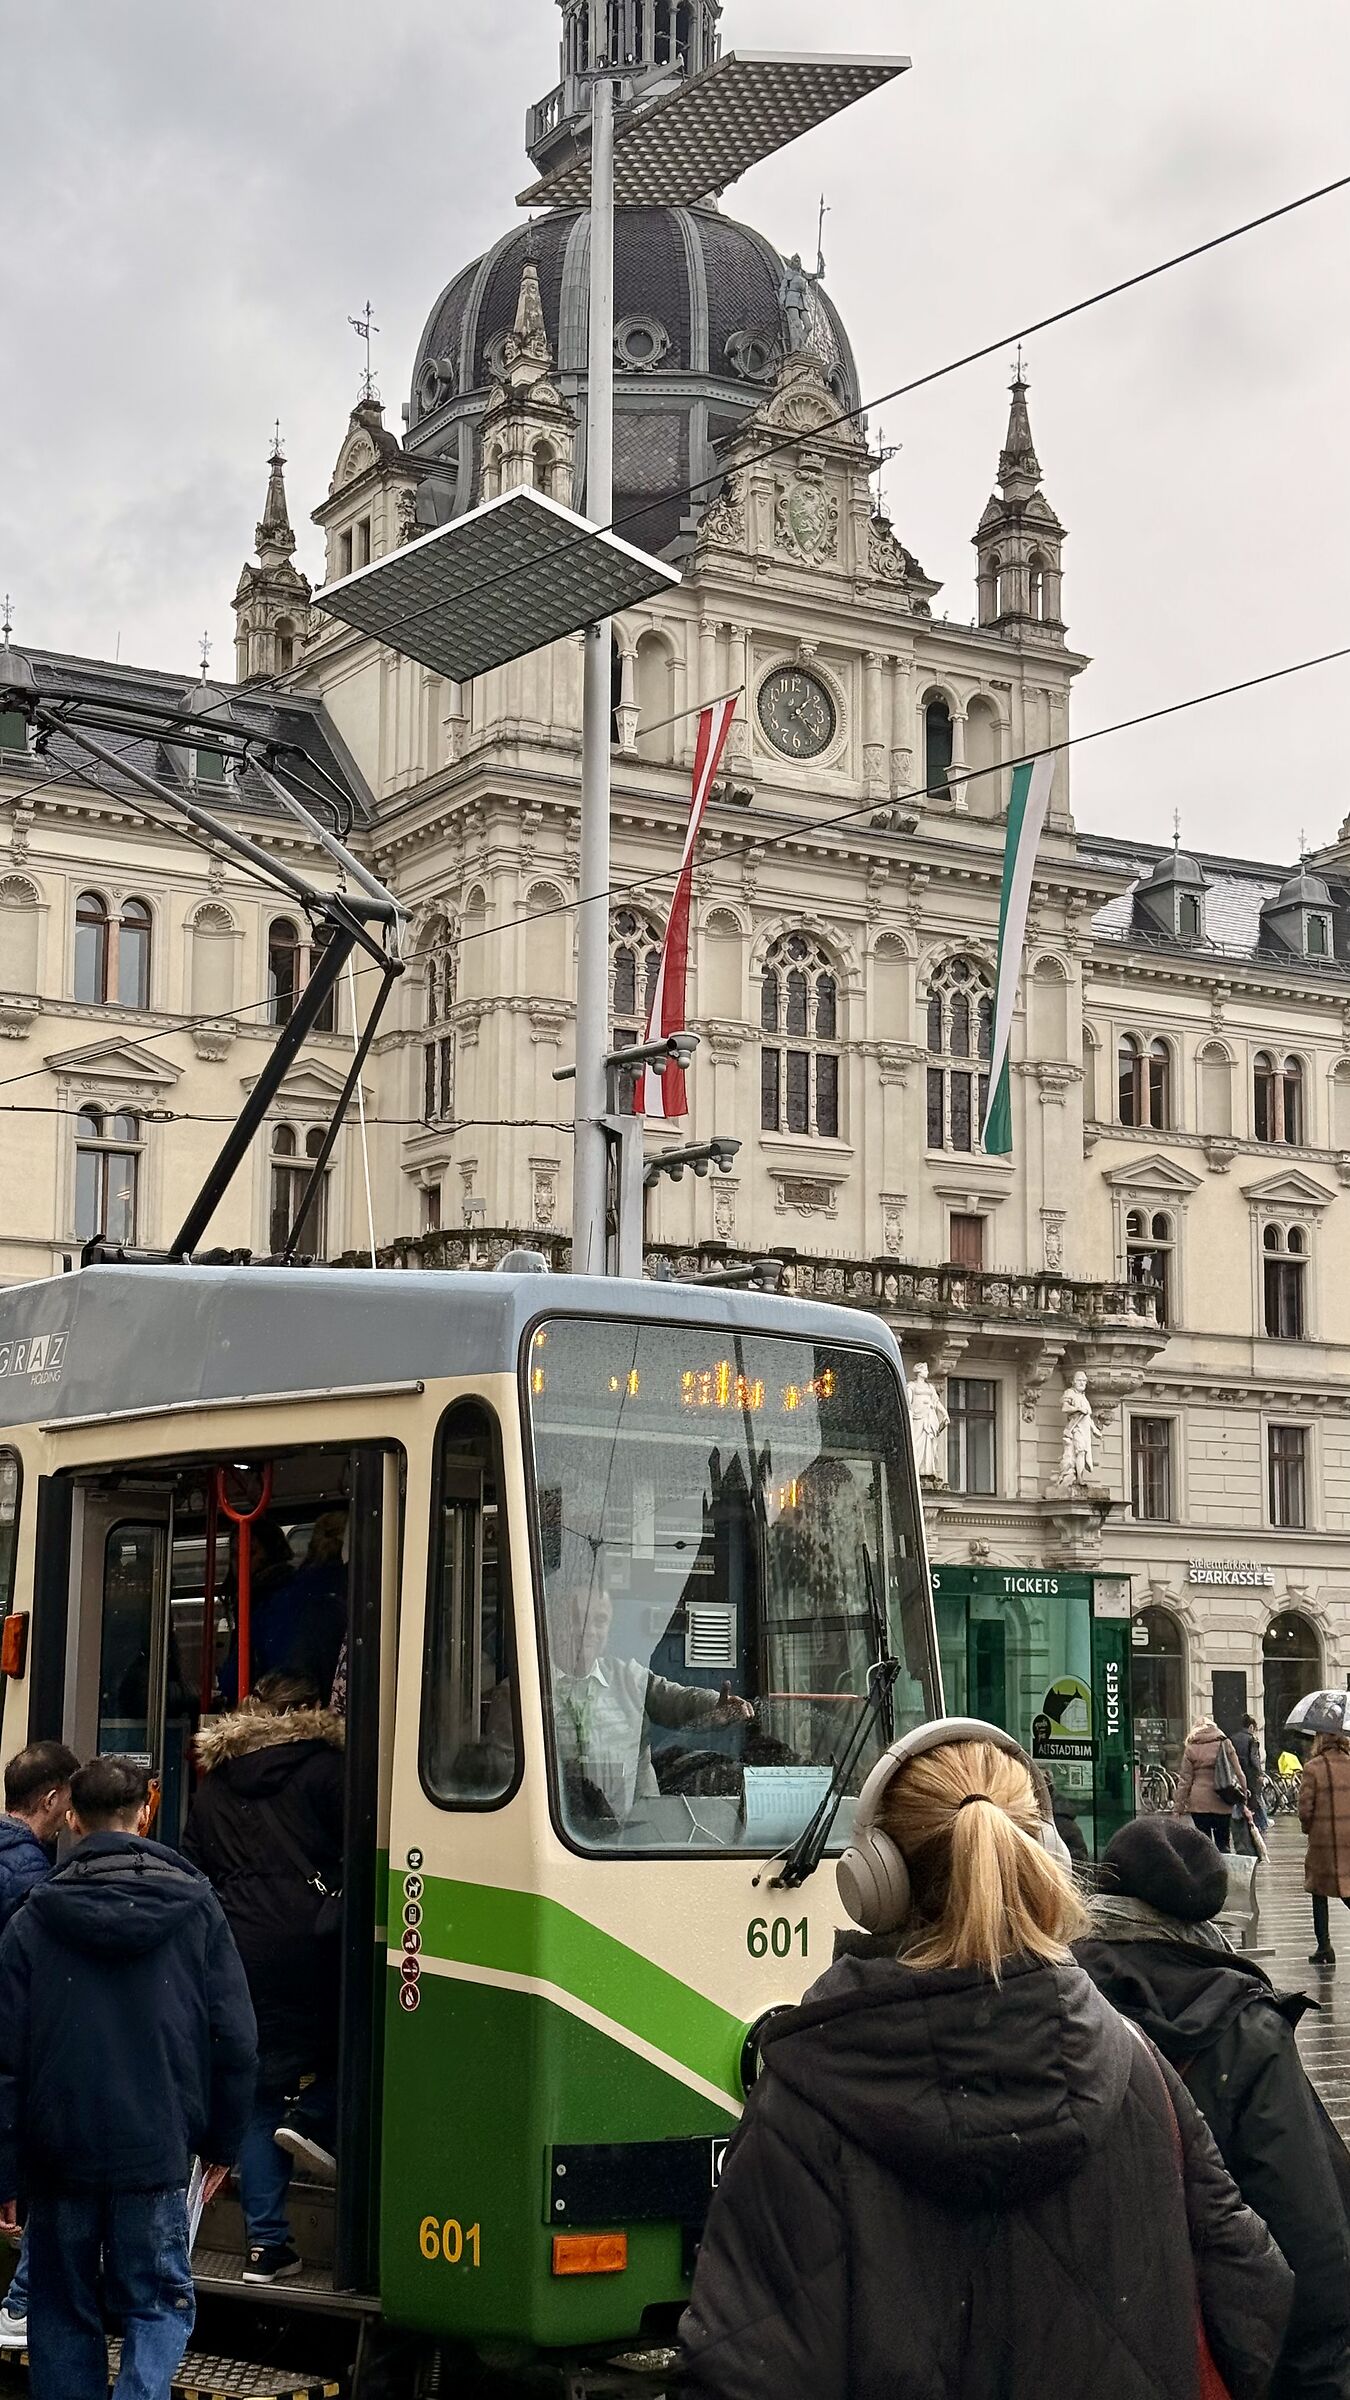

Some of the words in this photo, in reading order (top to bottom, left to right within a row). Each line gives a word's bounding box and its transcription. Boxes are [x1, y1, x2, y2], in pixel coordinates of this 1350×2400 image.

[767, 702, 775, 716] 9
[812, 695, 820, 709] 2
[816, 709, 824, 724] 3
[781, 728, 790, 744] 7
[792, 731, 801, 748] 6
[30, 1369, 62, 1385] HOLDING
[1003, 1577, 1059, 1594] TICKETS
[1106, 1662, 1119, 1736] TICKETS
[1038, 1743, 1092, 1757] ALTSTADTBIM
[746, 1917, 808, 1958] 601
[419, 2216, 480, 2267] 601
